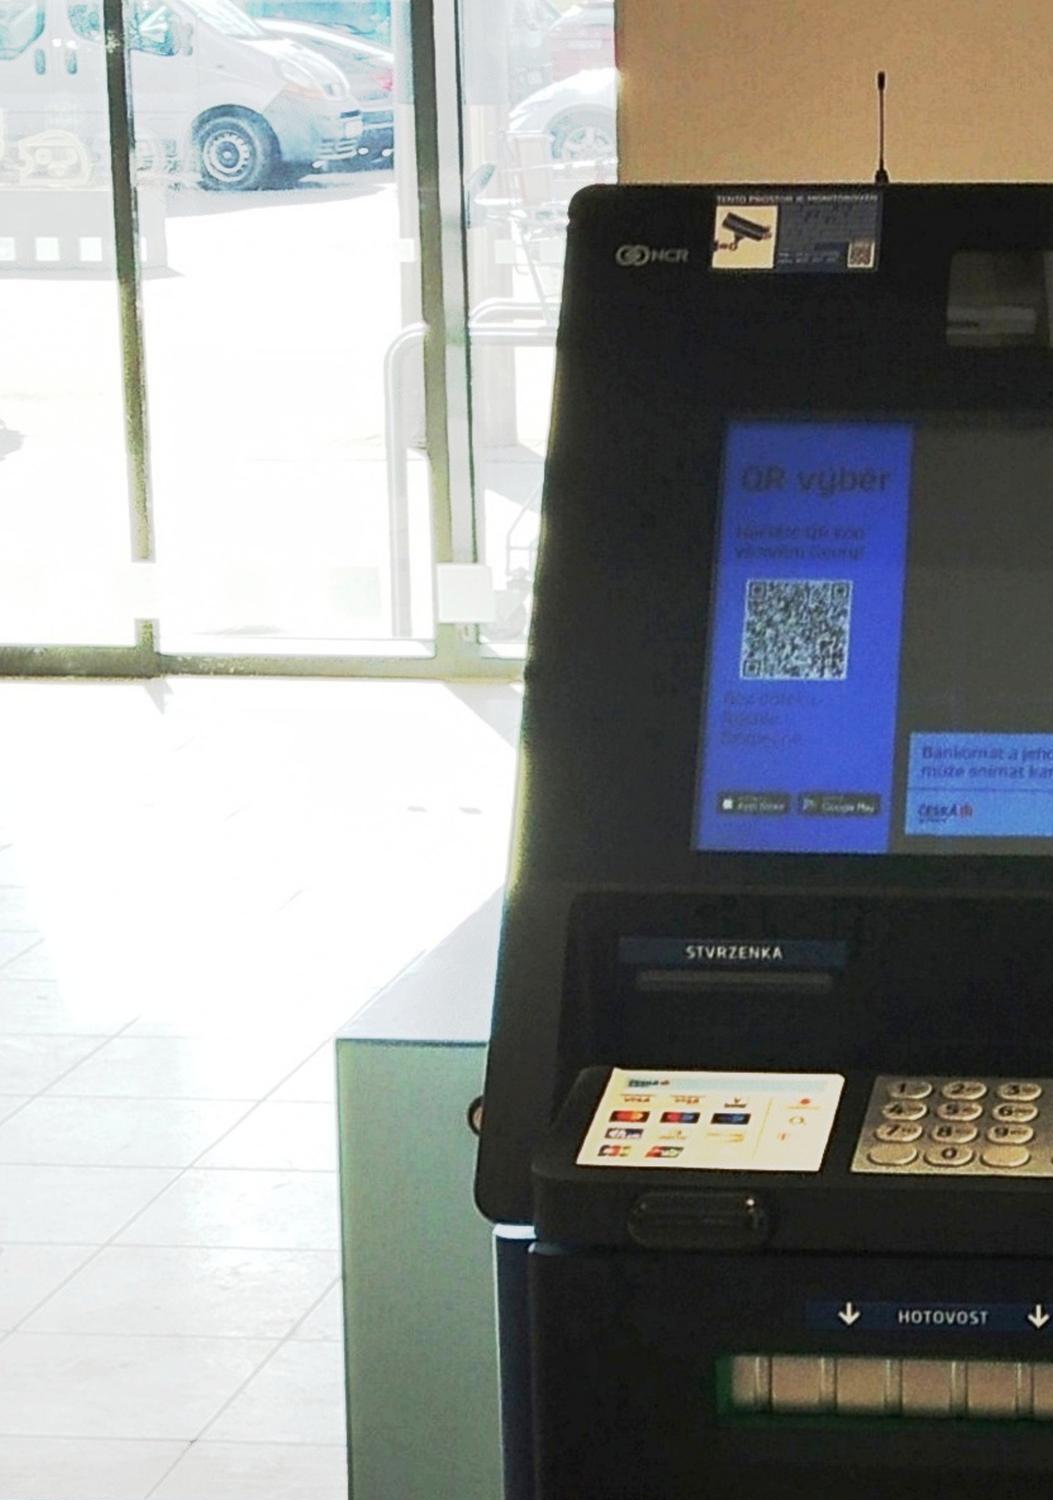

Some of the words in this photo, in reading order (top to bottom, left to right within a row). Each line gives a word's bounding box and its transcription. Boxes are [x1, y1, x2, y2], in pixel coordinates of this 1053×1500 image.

[651, 249, 689, 263] NCR
[741, 463, 786, 492] QR
[921, 746, 1004, 761] Bankomat
[1007, 749, 1019, 761] a
[685, 944, 783, 960] STVRZENKA
[898, 1308, 989, 1325] HOTOVOST
